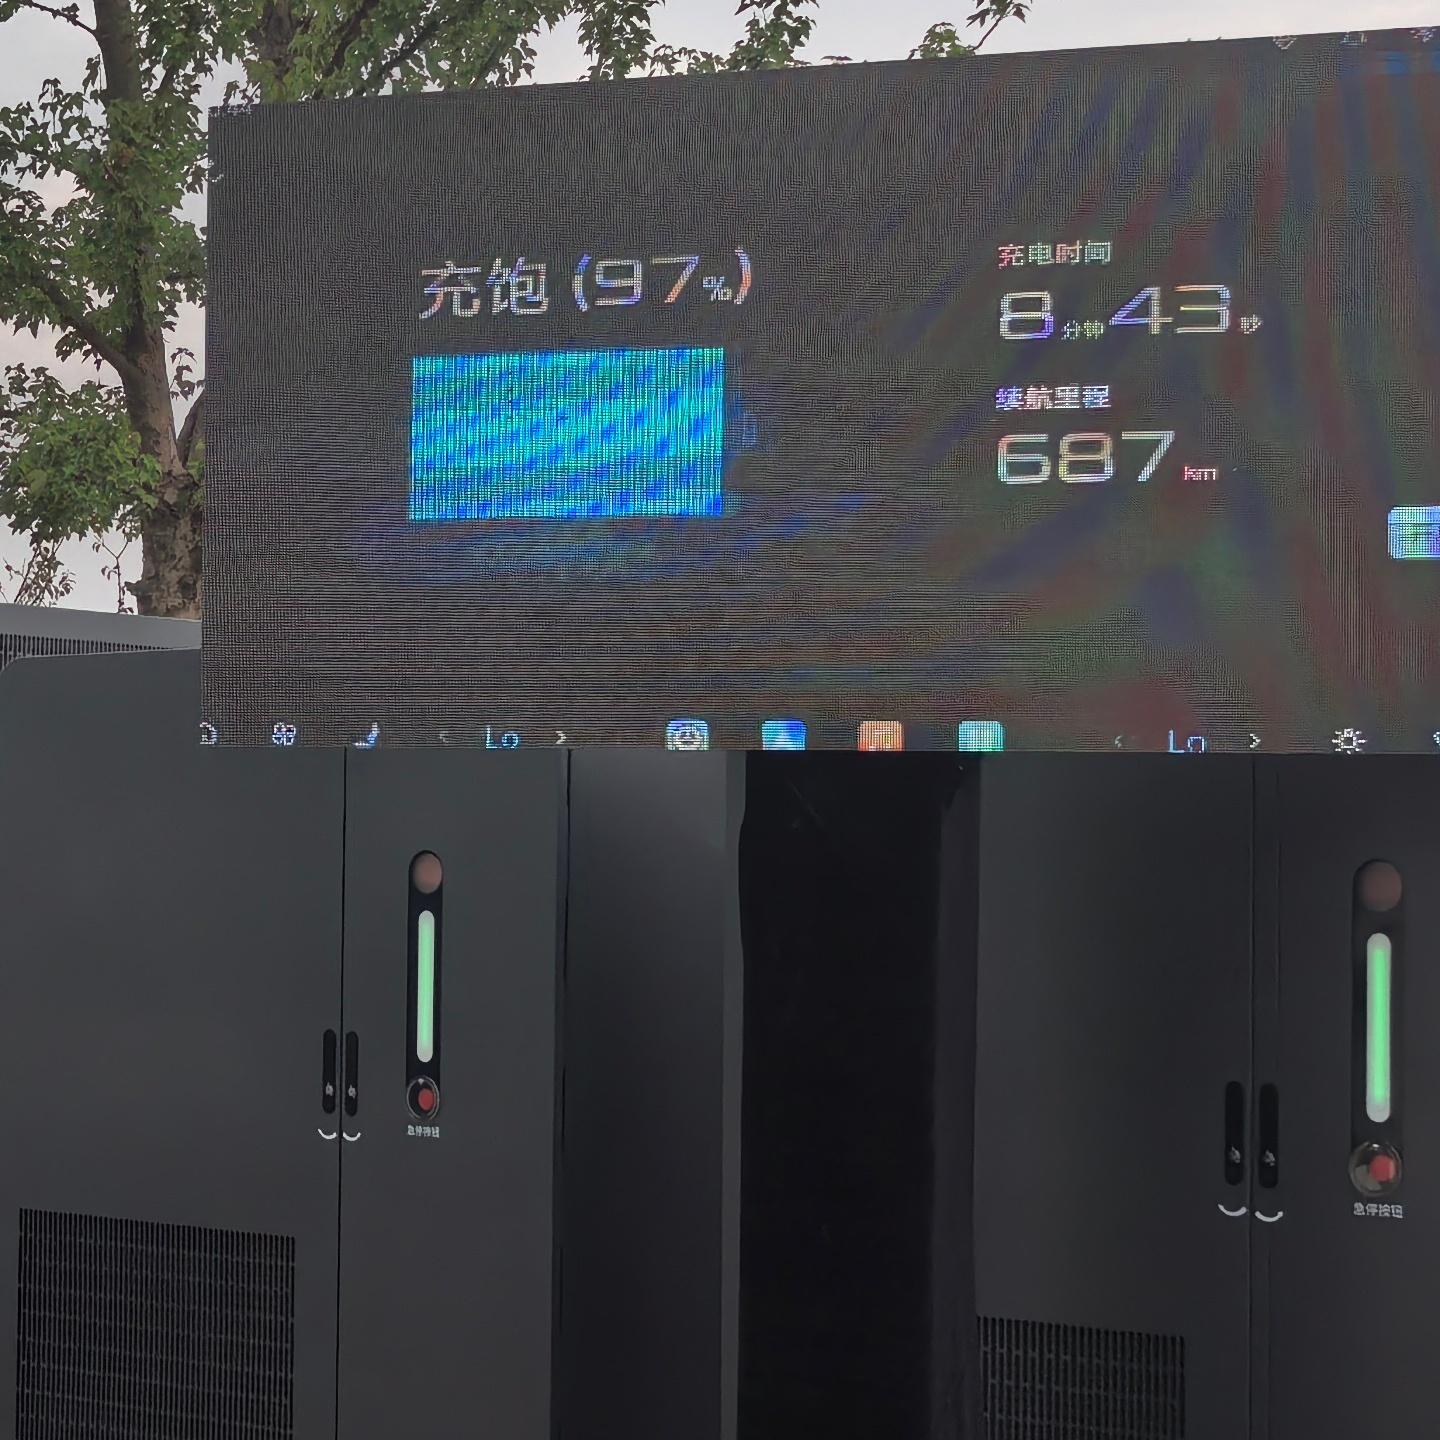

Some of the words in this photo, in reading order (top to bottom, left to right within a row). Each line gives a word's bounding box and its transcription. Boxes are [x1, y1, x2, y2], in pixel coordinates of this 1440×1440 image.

[998, 240, 1112, 269] 充电时间
[419, 257, 549, 319] 充饱
[998, 430, 1175, 484] 687
